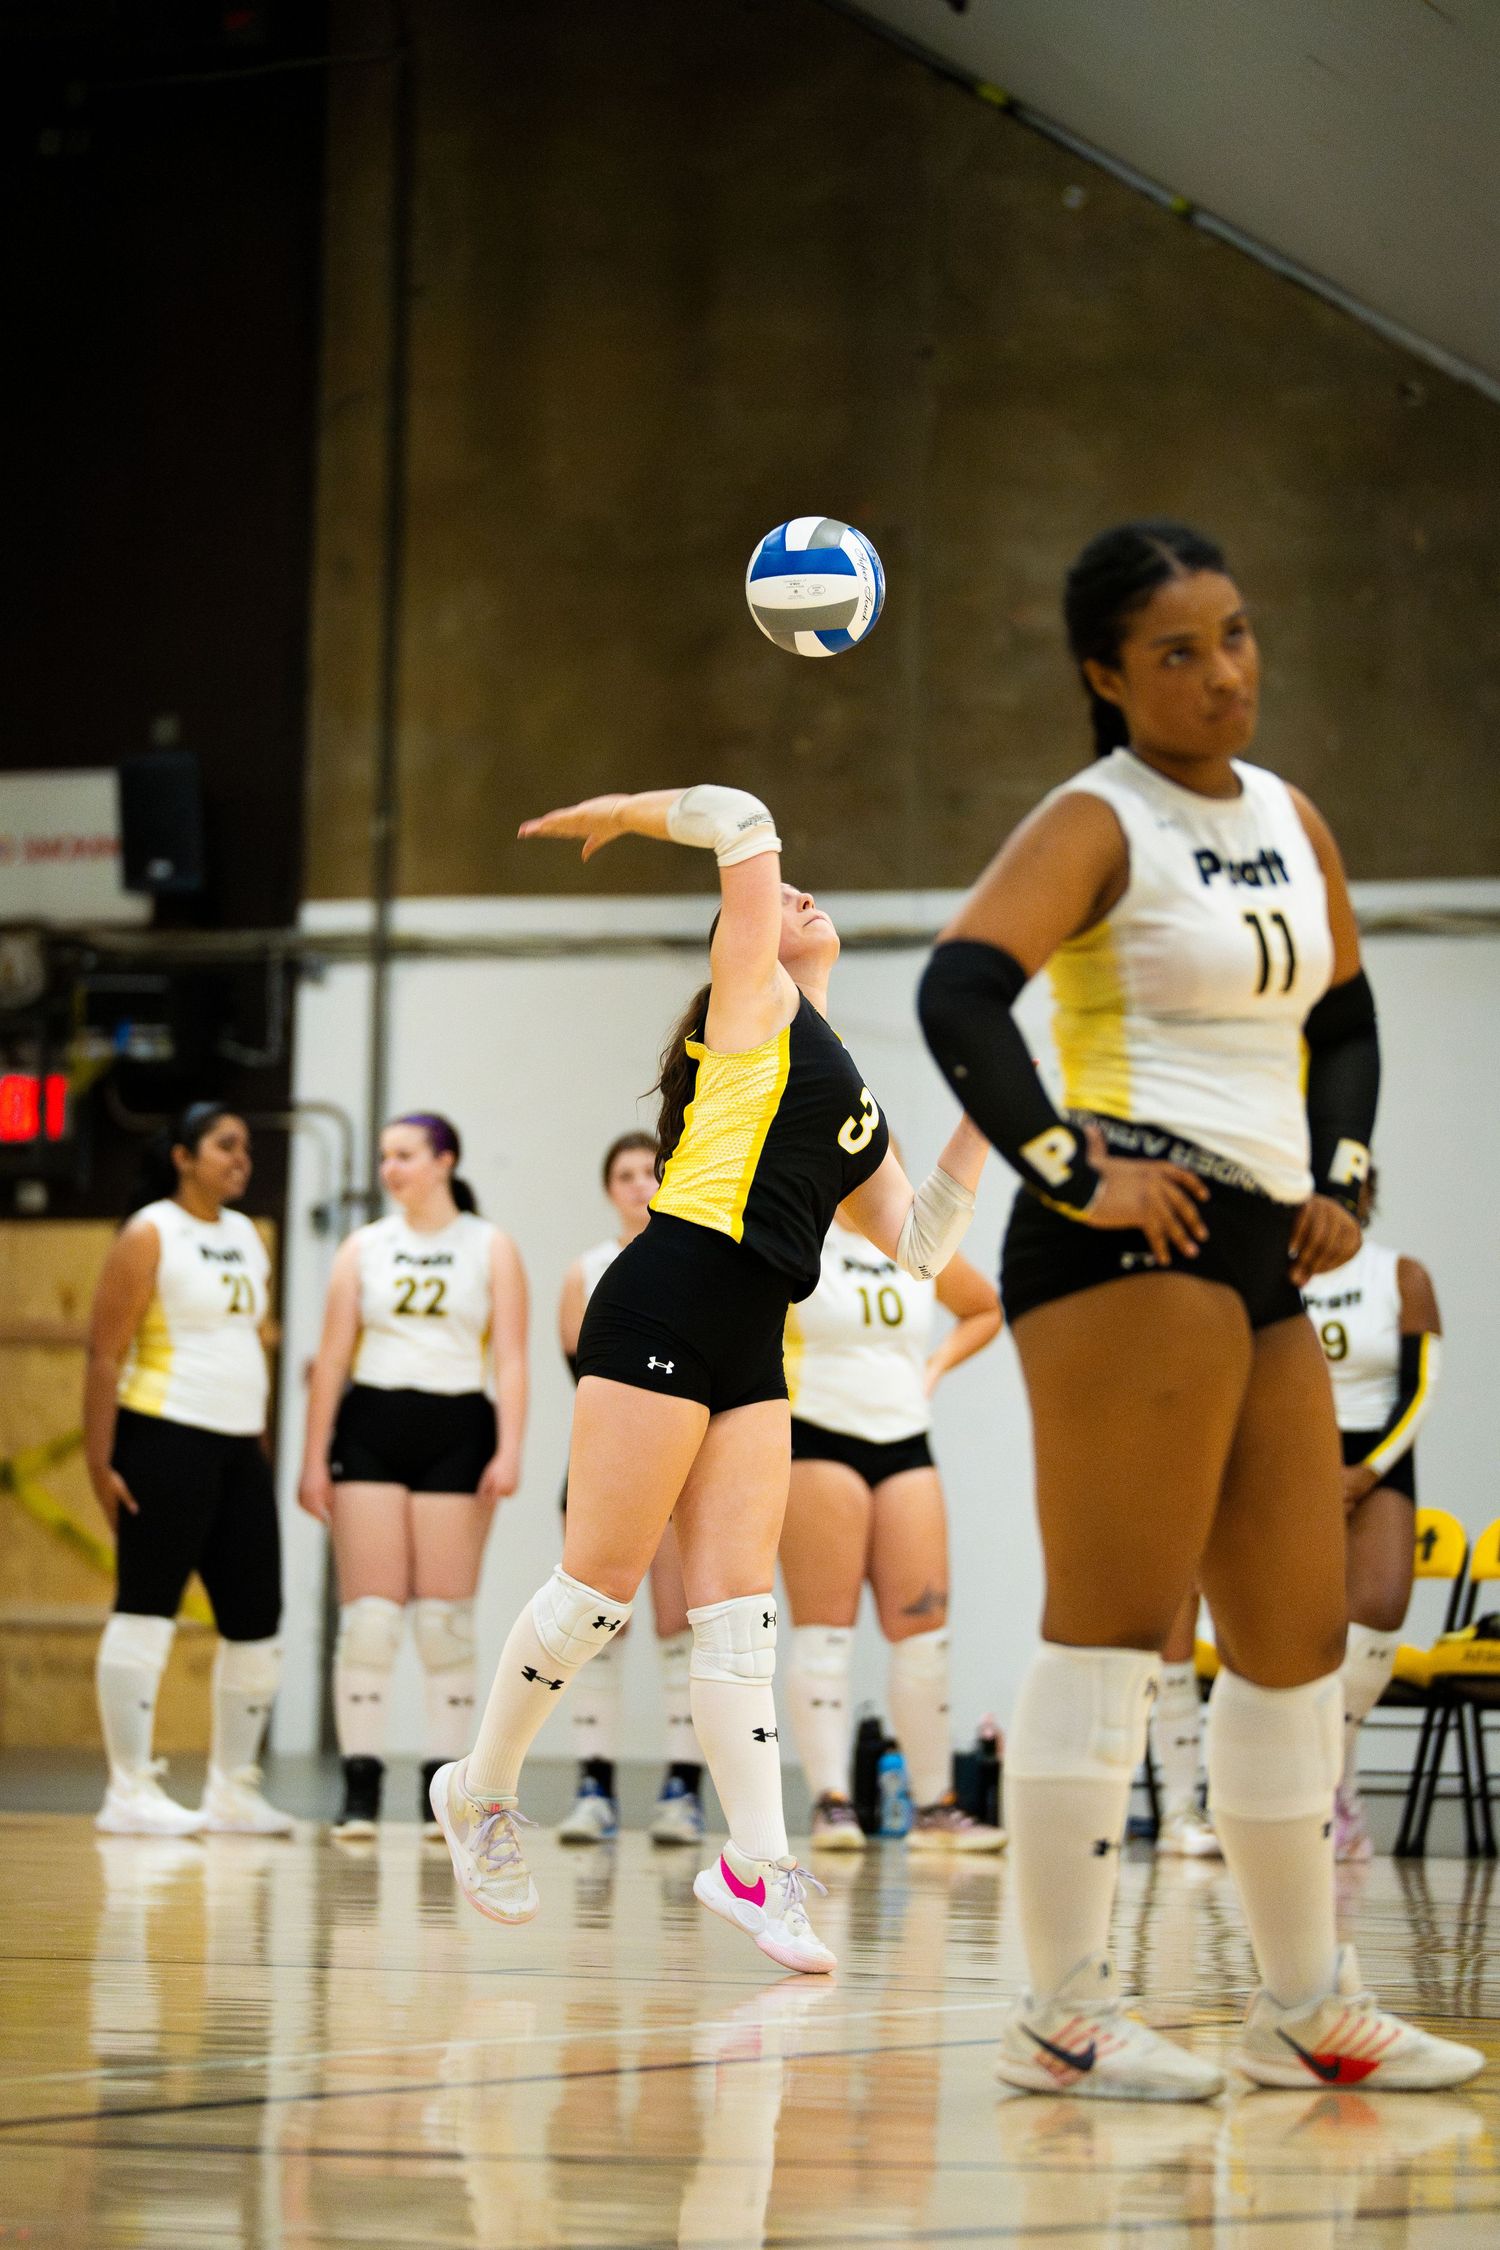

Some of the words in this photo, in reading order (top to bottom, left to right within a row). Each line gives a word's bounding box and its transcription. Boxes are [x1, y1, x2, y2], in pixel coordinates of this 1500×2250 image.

[854, 547, 868, 583] Super
[862, 585, 873, 622] Touch
[1194, 848, 1289, 887] Pratt
[1243, 909, 1297, 996] 11
[837, 1086, 880, 1155] 3
[220, 1272, 255, 1316] 21
[392, 1275, 448, 1318] 22
[856, 1285, 904, 1328] 10
[1321, 1320, 1348, 1362] 9
